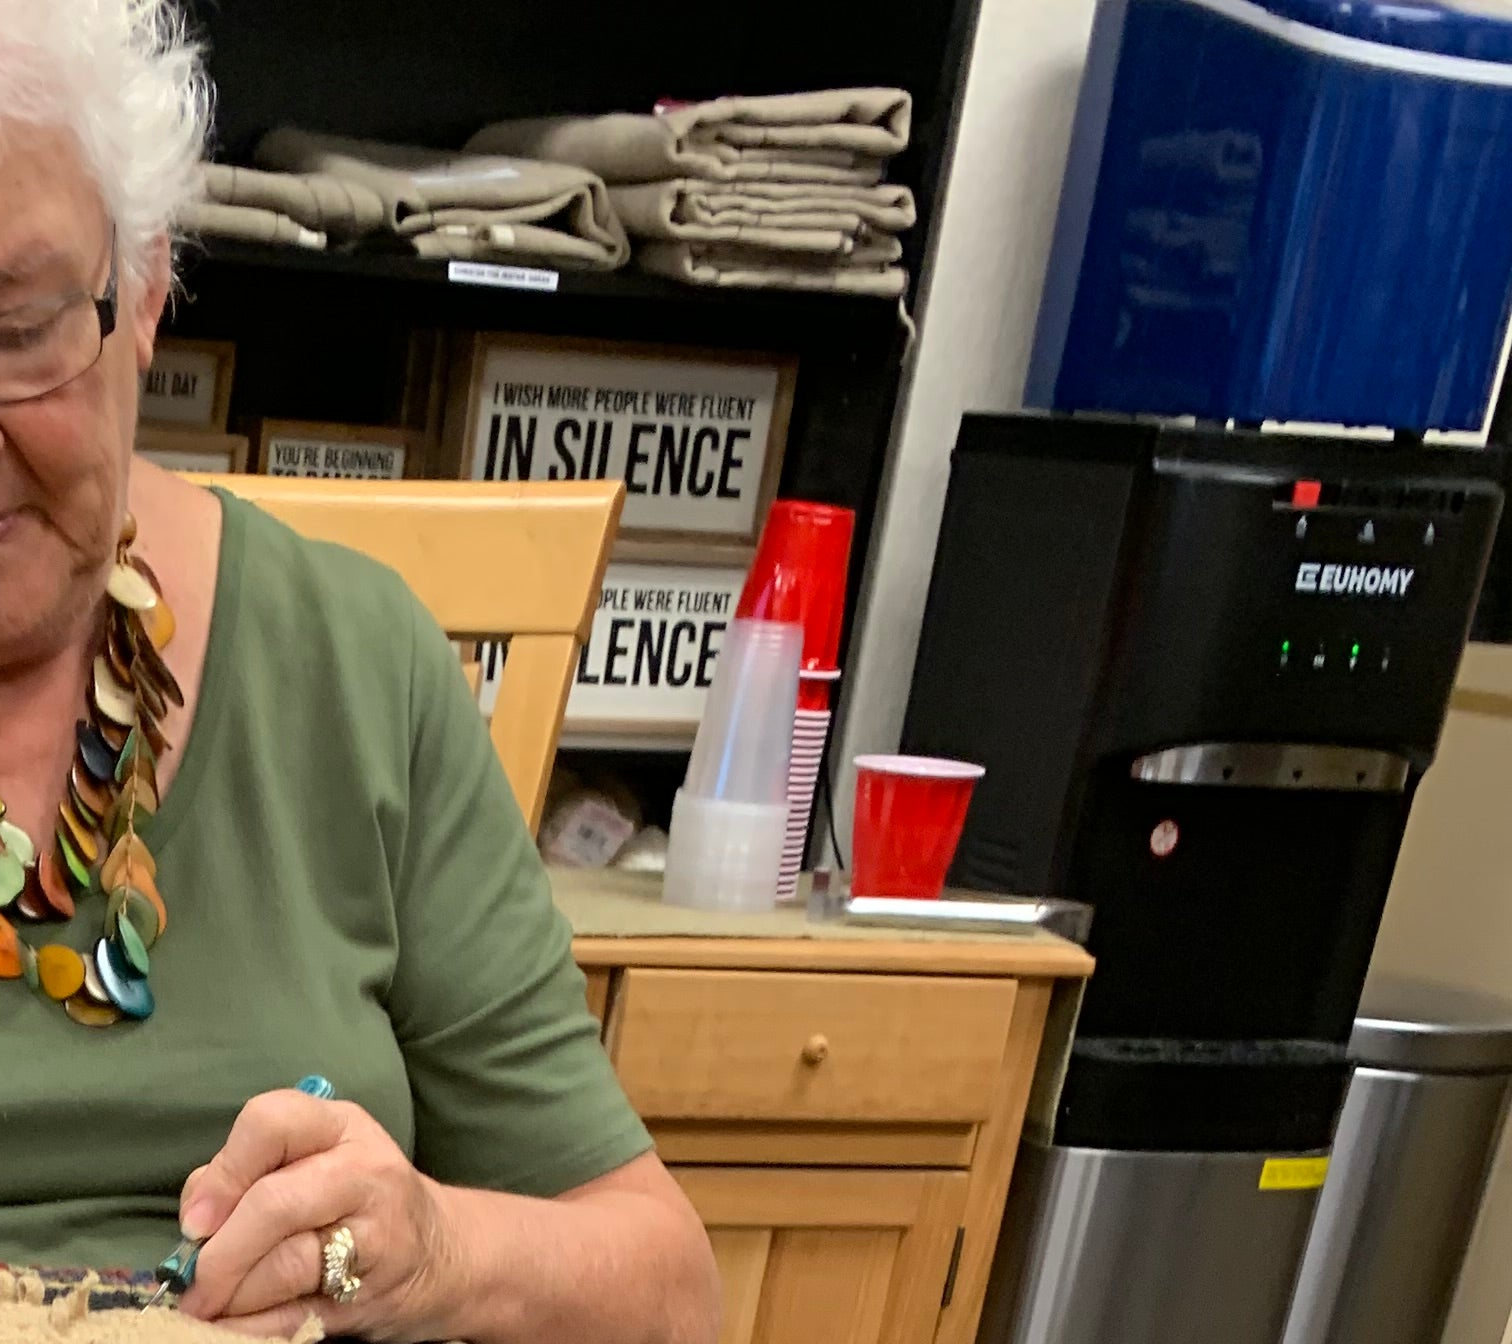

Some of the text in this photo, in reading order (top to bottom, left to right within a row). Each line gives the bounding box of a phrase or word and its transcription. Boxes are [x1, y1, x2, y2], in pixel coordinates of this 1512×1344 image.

[494, 381, 756, 420] I WISH MORE PEOPLE WERE FLUENT
[484, 414, 751, 499] IN SILENCE
[634, 589, 674, 612] WERE
[677, 590, 732, 614] FLUENT
